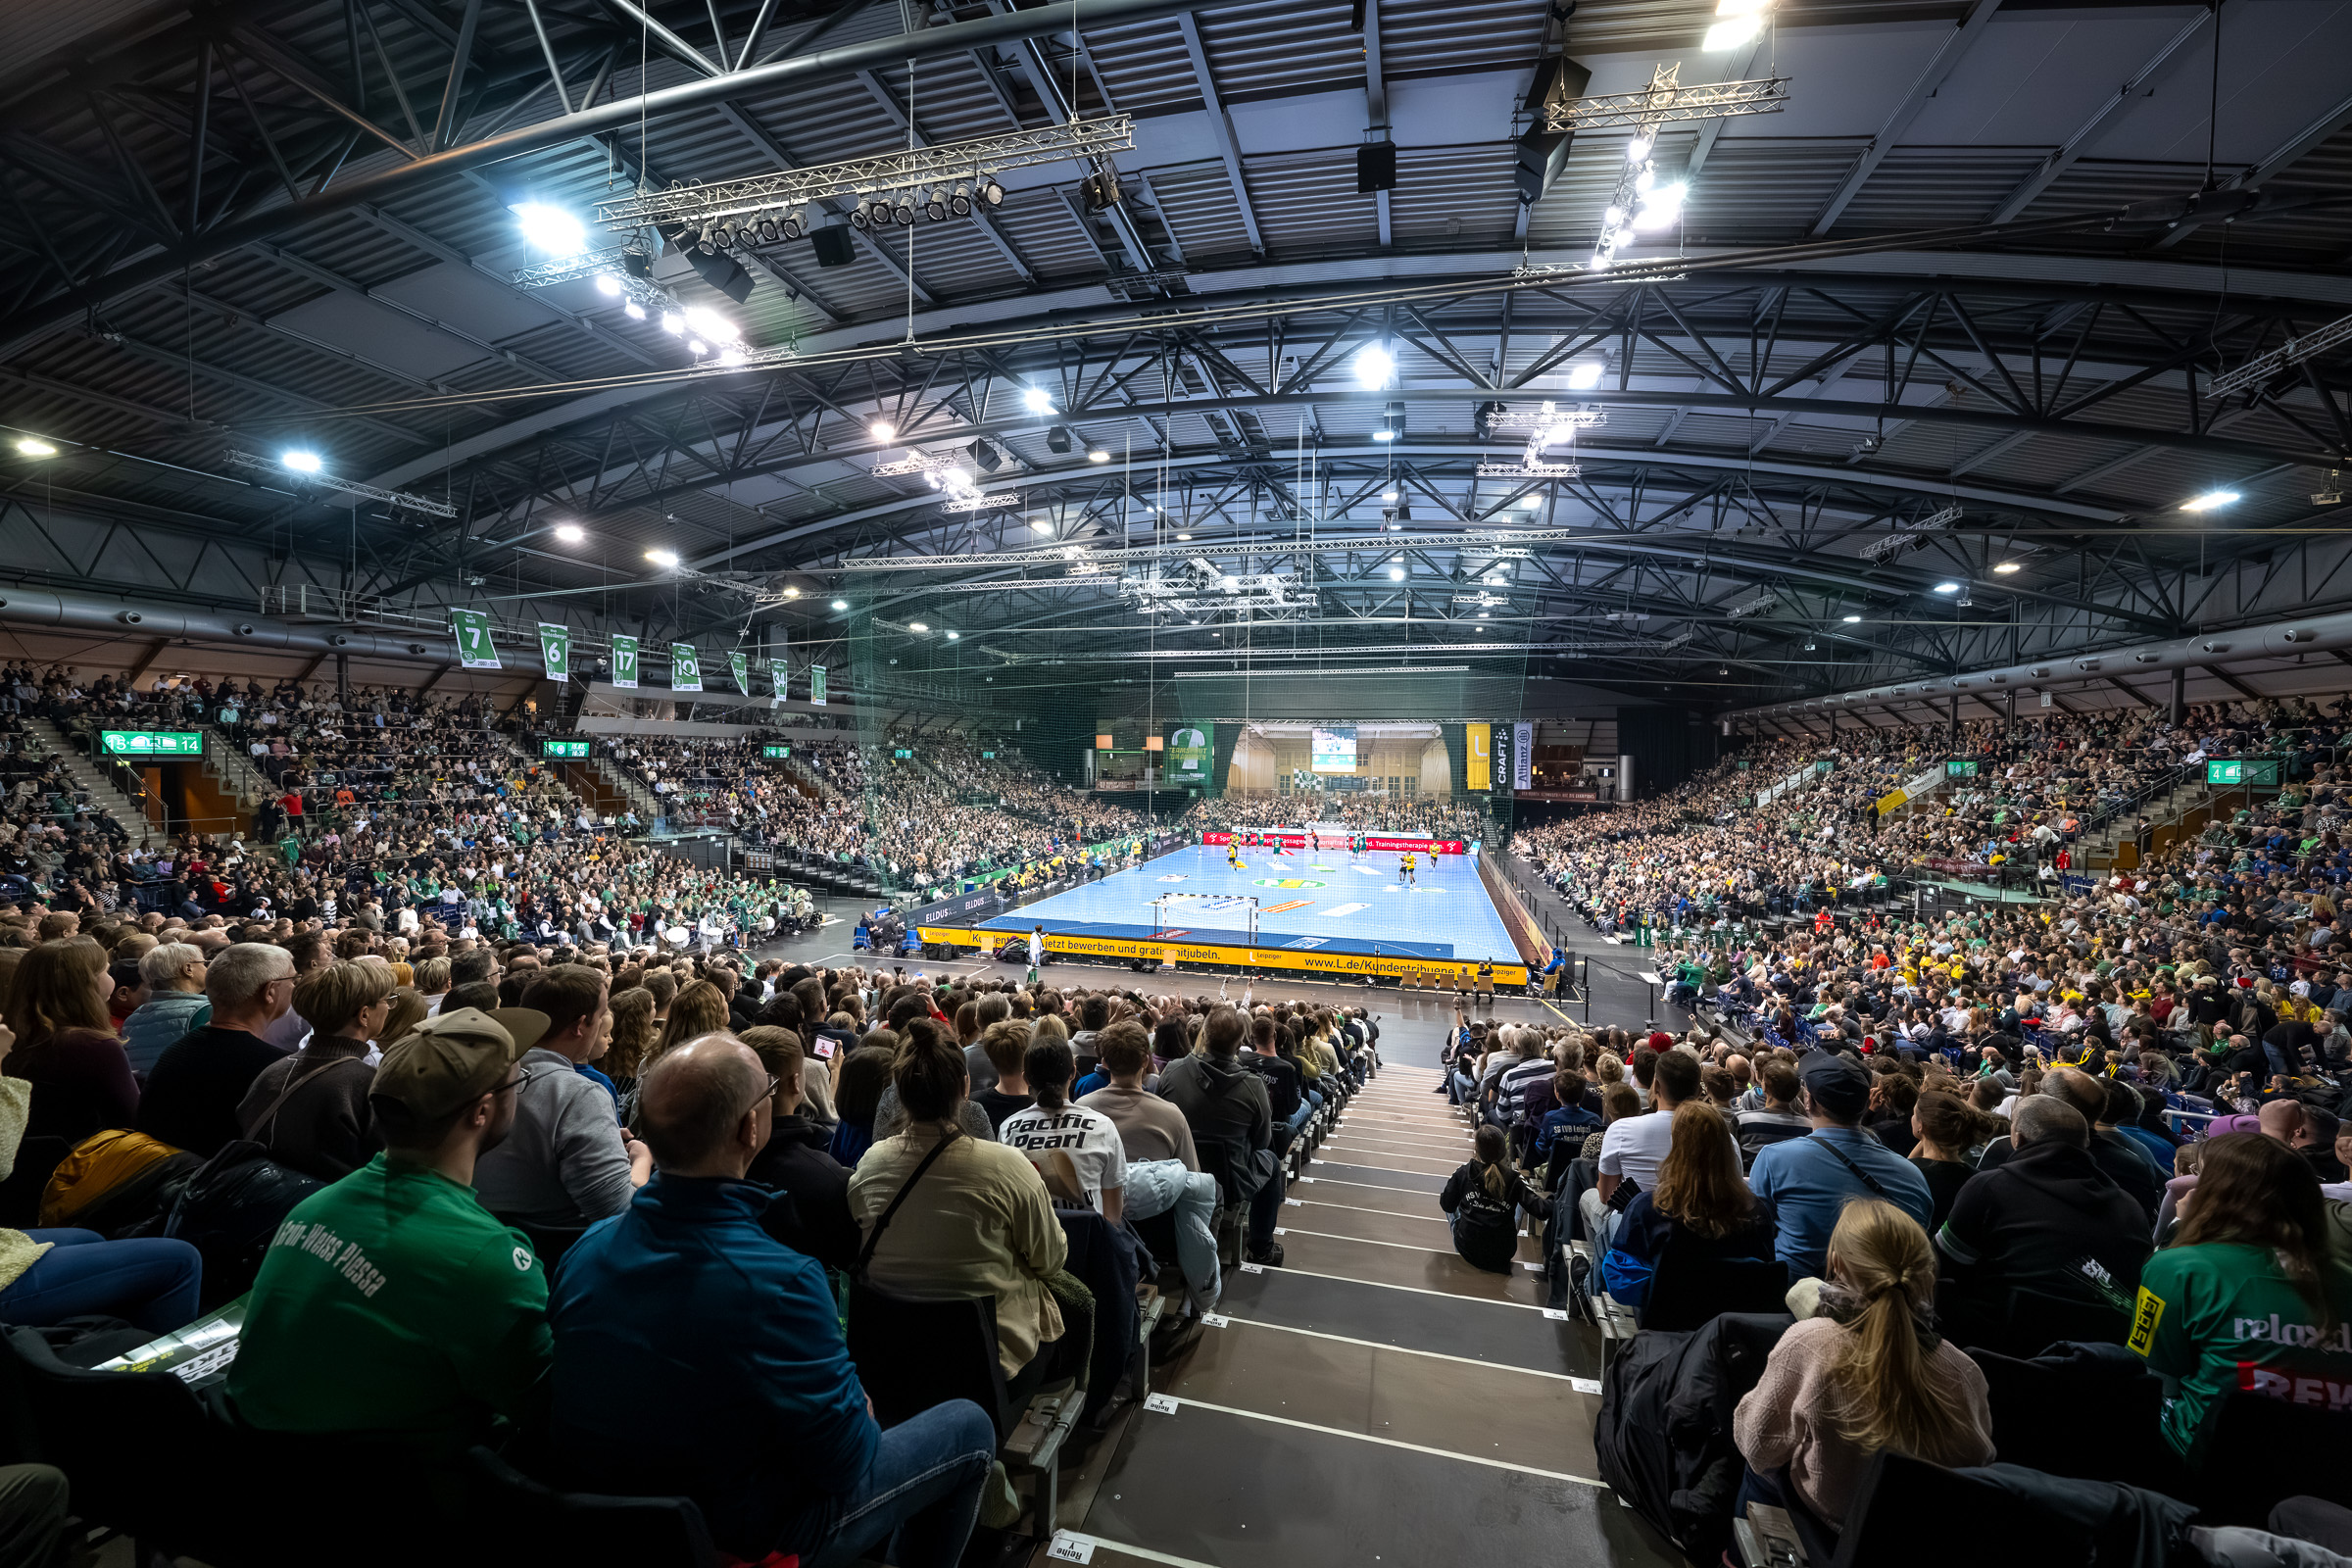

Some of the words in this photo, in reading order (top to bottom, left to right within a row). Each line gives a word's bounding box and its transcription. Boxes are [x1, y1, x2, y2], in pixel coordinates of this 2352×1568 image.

[465, 626, 481, 650] 7
[549, 642, 562, 662] 6
[616, 651, 635, 671] 17
[676, 659, 696, 677] 10
[773, 671, 786, 688] 34
[180, 740, 199, 752] 14
[1497, 740, 1507, 784] CRAFT
[1517, 742, 1528, 783] Allianz
[2213, 768, 2220, 780] 4
[2263, 768, 2272, 781] 3
[1375, 840, 1428, 850] Trainingstherapie
[965, 897, 985, 910] ELLDUS
[925, 908, 949, 923] ELLDUS
[1045, 938, 1065, 951] jetzt
[1067, 940, 1115, 955] bewerben
[1117, 943, 1137, 954] und
[1256, 952, 1282, 960] Leipziger
[1490, 967, 1517, 977] eipziger
[1005, 1113, 1097, 1140] Pacific
[1013, 1131, 1087, 1151] Pearl
[333, 1242, 387, 1298] Plessa
[1150, 1402, 1170, 1412] Reihe
[1055, 1547, 1083, 1560] Reihe
[1068, 1542, 1075, 1550] Y
